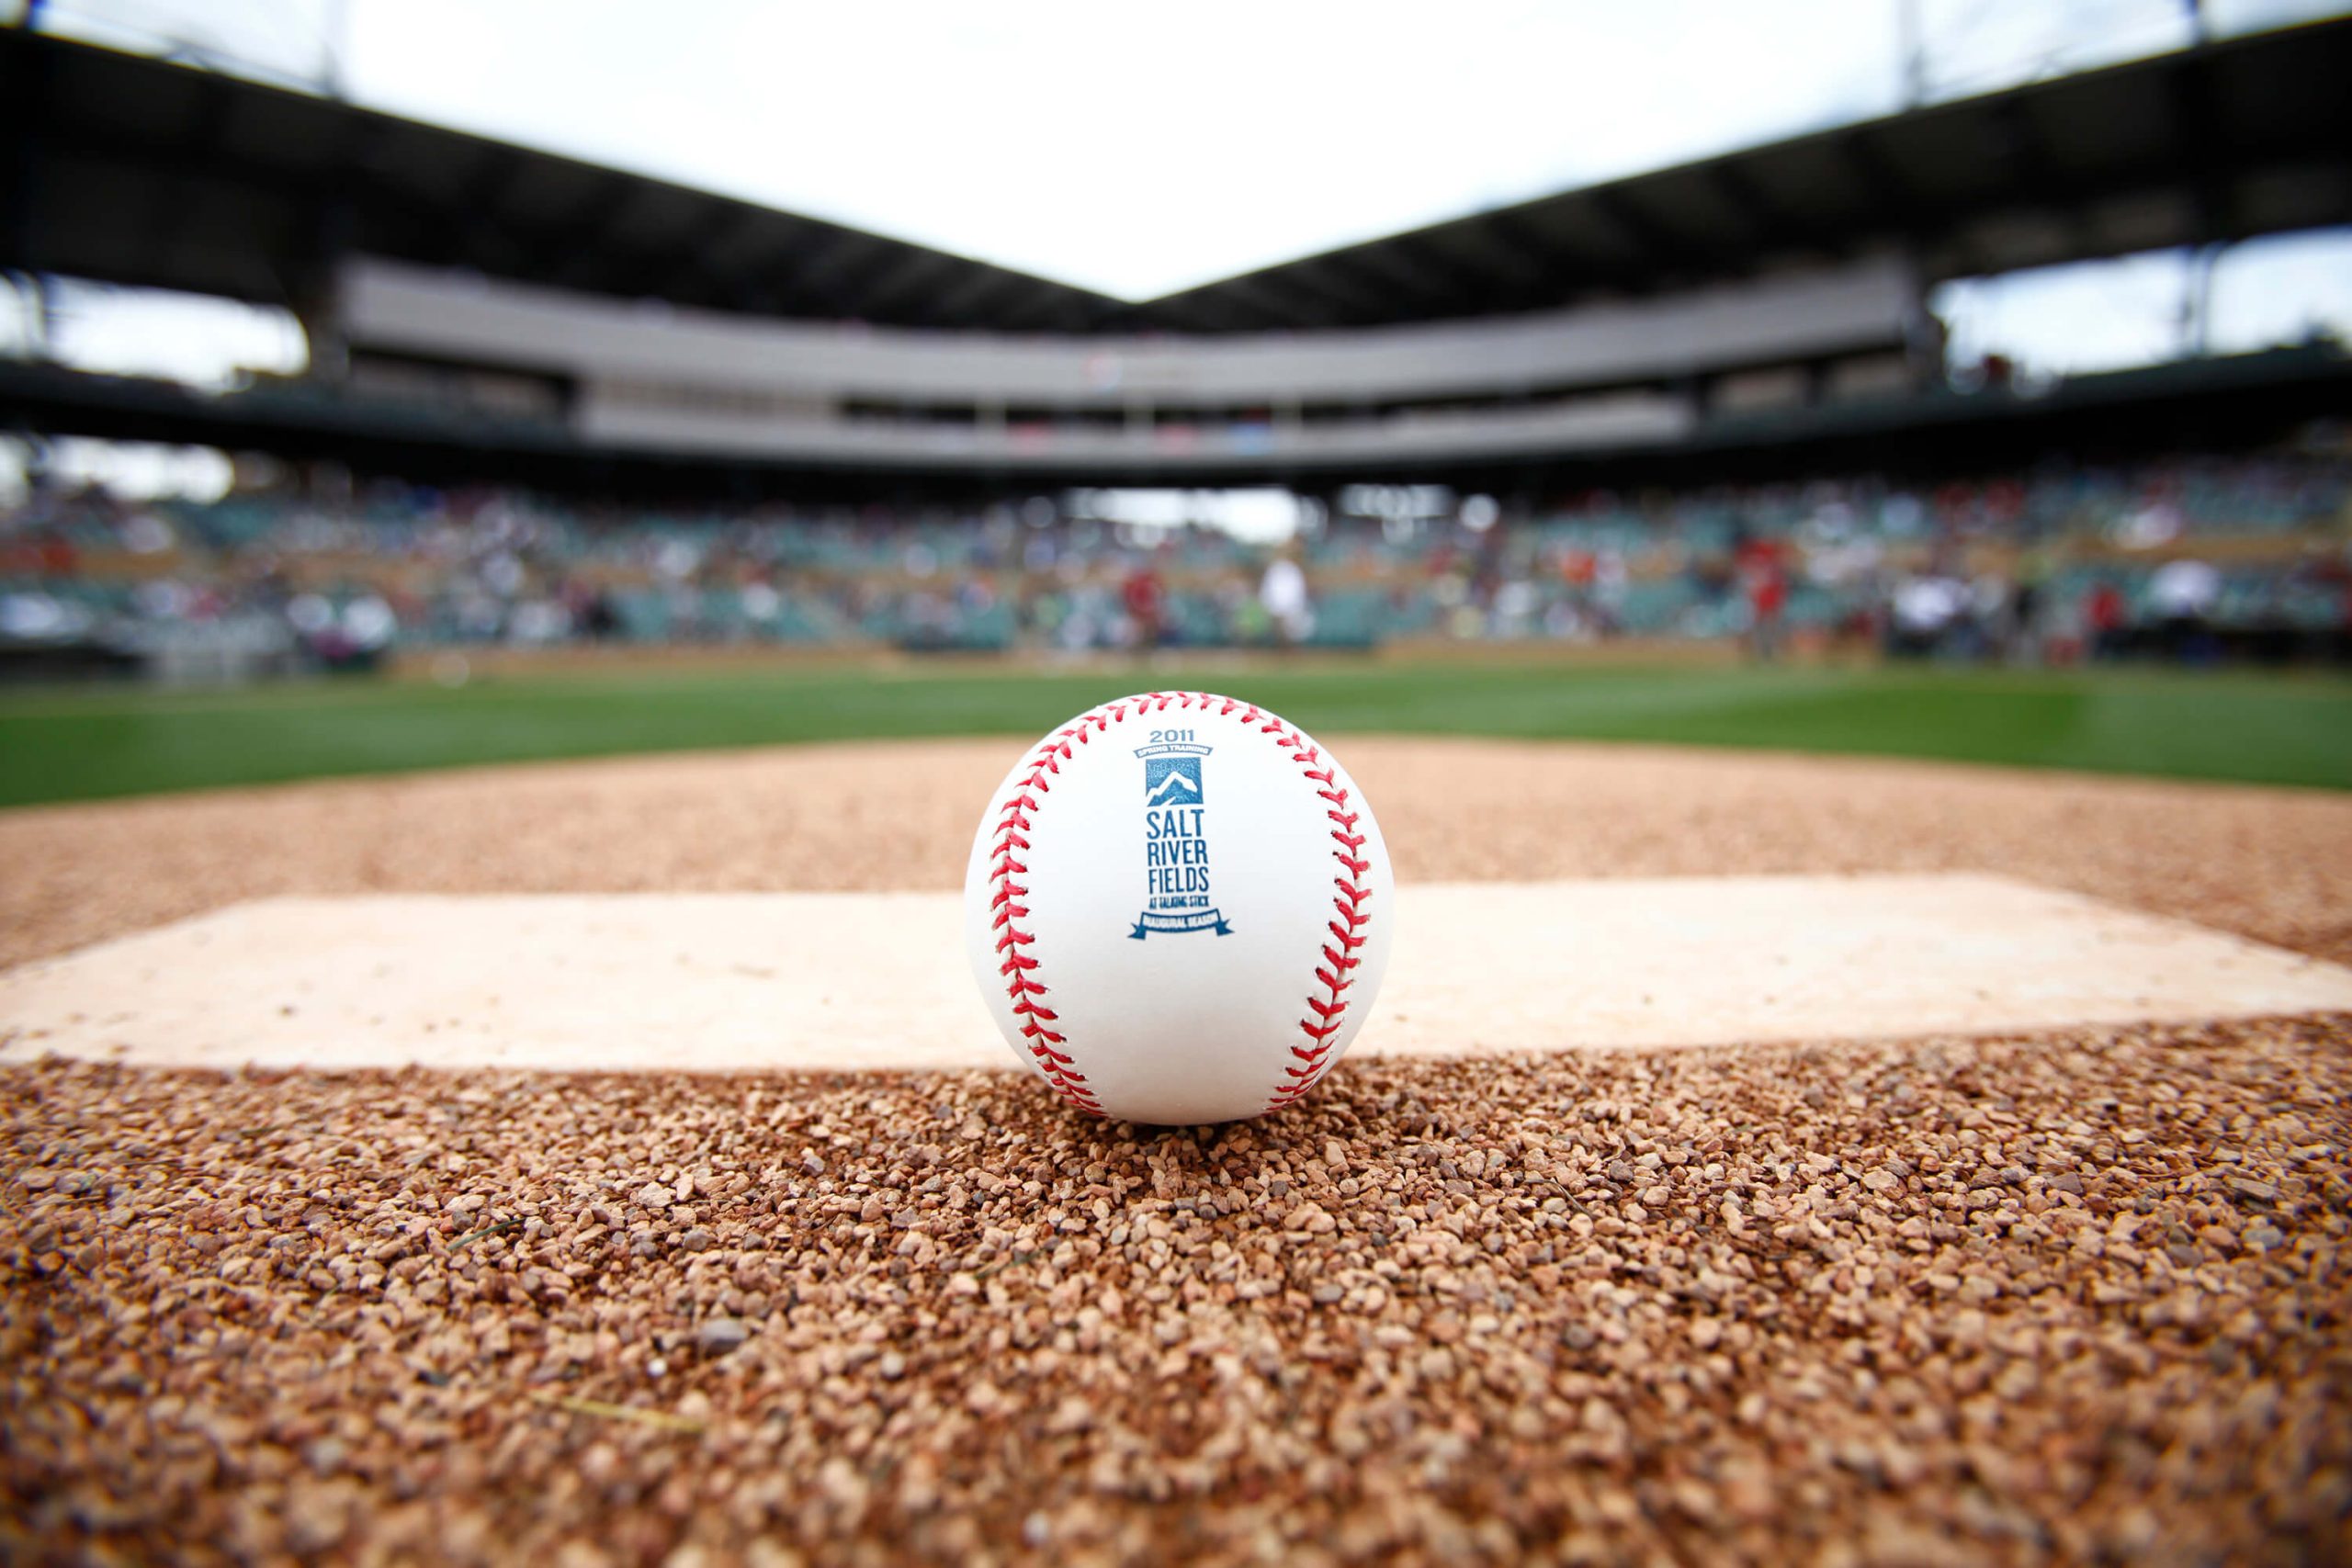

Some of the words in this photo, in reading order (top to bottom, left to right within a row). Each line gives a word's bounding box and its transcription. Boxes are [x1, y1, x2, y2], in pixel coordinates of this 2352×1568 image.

[1149, 729, 1194, 743] 2011
[1169, 744, 1209, 753] TRAINING
[1146, 808, 1204, 840] SALT
[1147, 839, 1208, 867] RIVER
[1148, 866, 1209, 895] FIELDS
